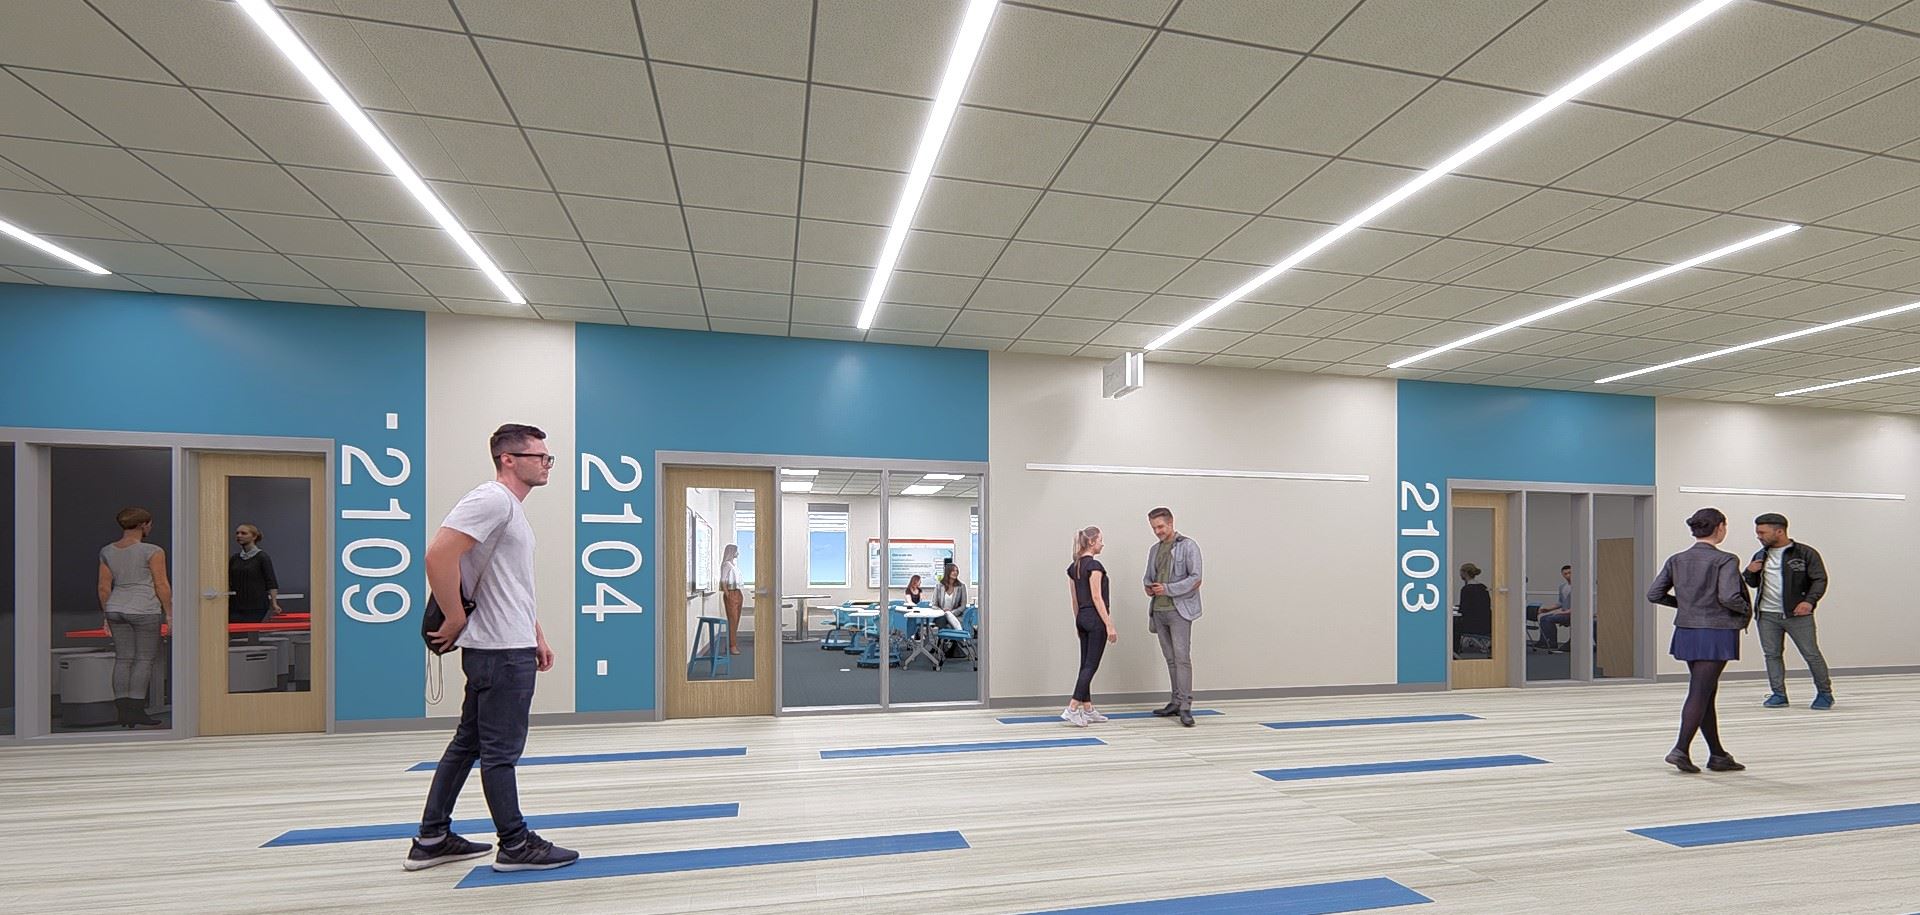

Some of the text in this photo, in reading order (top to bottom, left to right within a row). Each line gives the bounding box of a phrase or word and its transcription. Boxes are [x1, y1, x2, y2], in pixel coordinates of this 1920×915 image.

[341, 445, 411, 623] 2109
[581, 452, 642, 622] 2104
[1401, 480, 1440, 612] 2103
